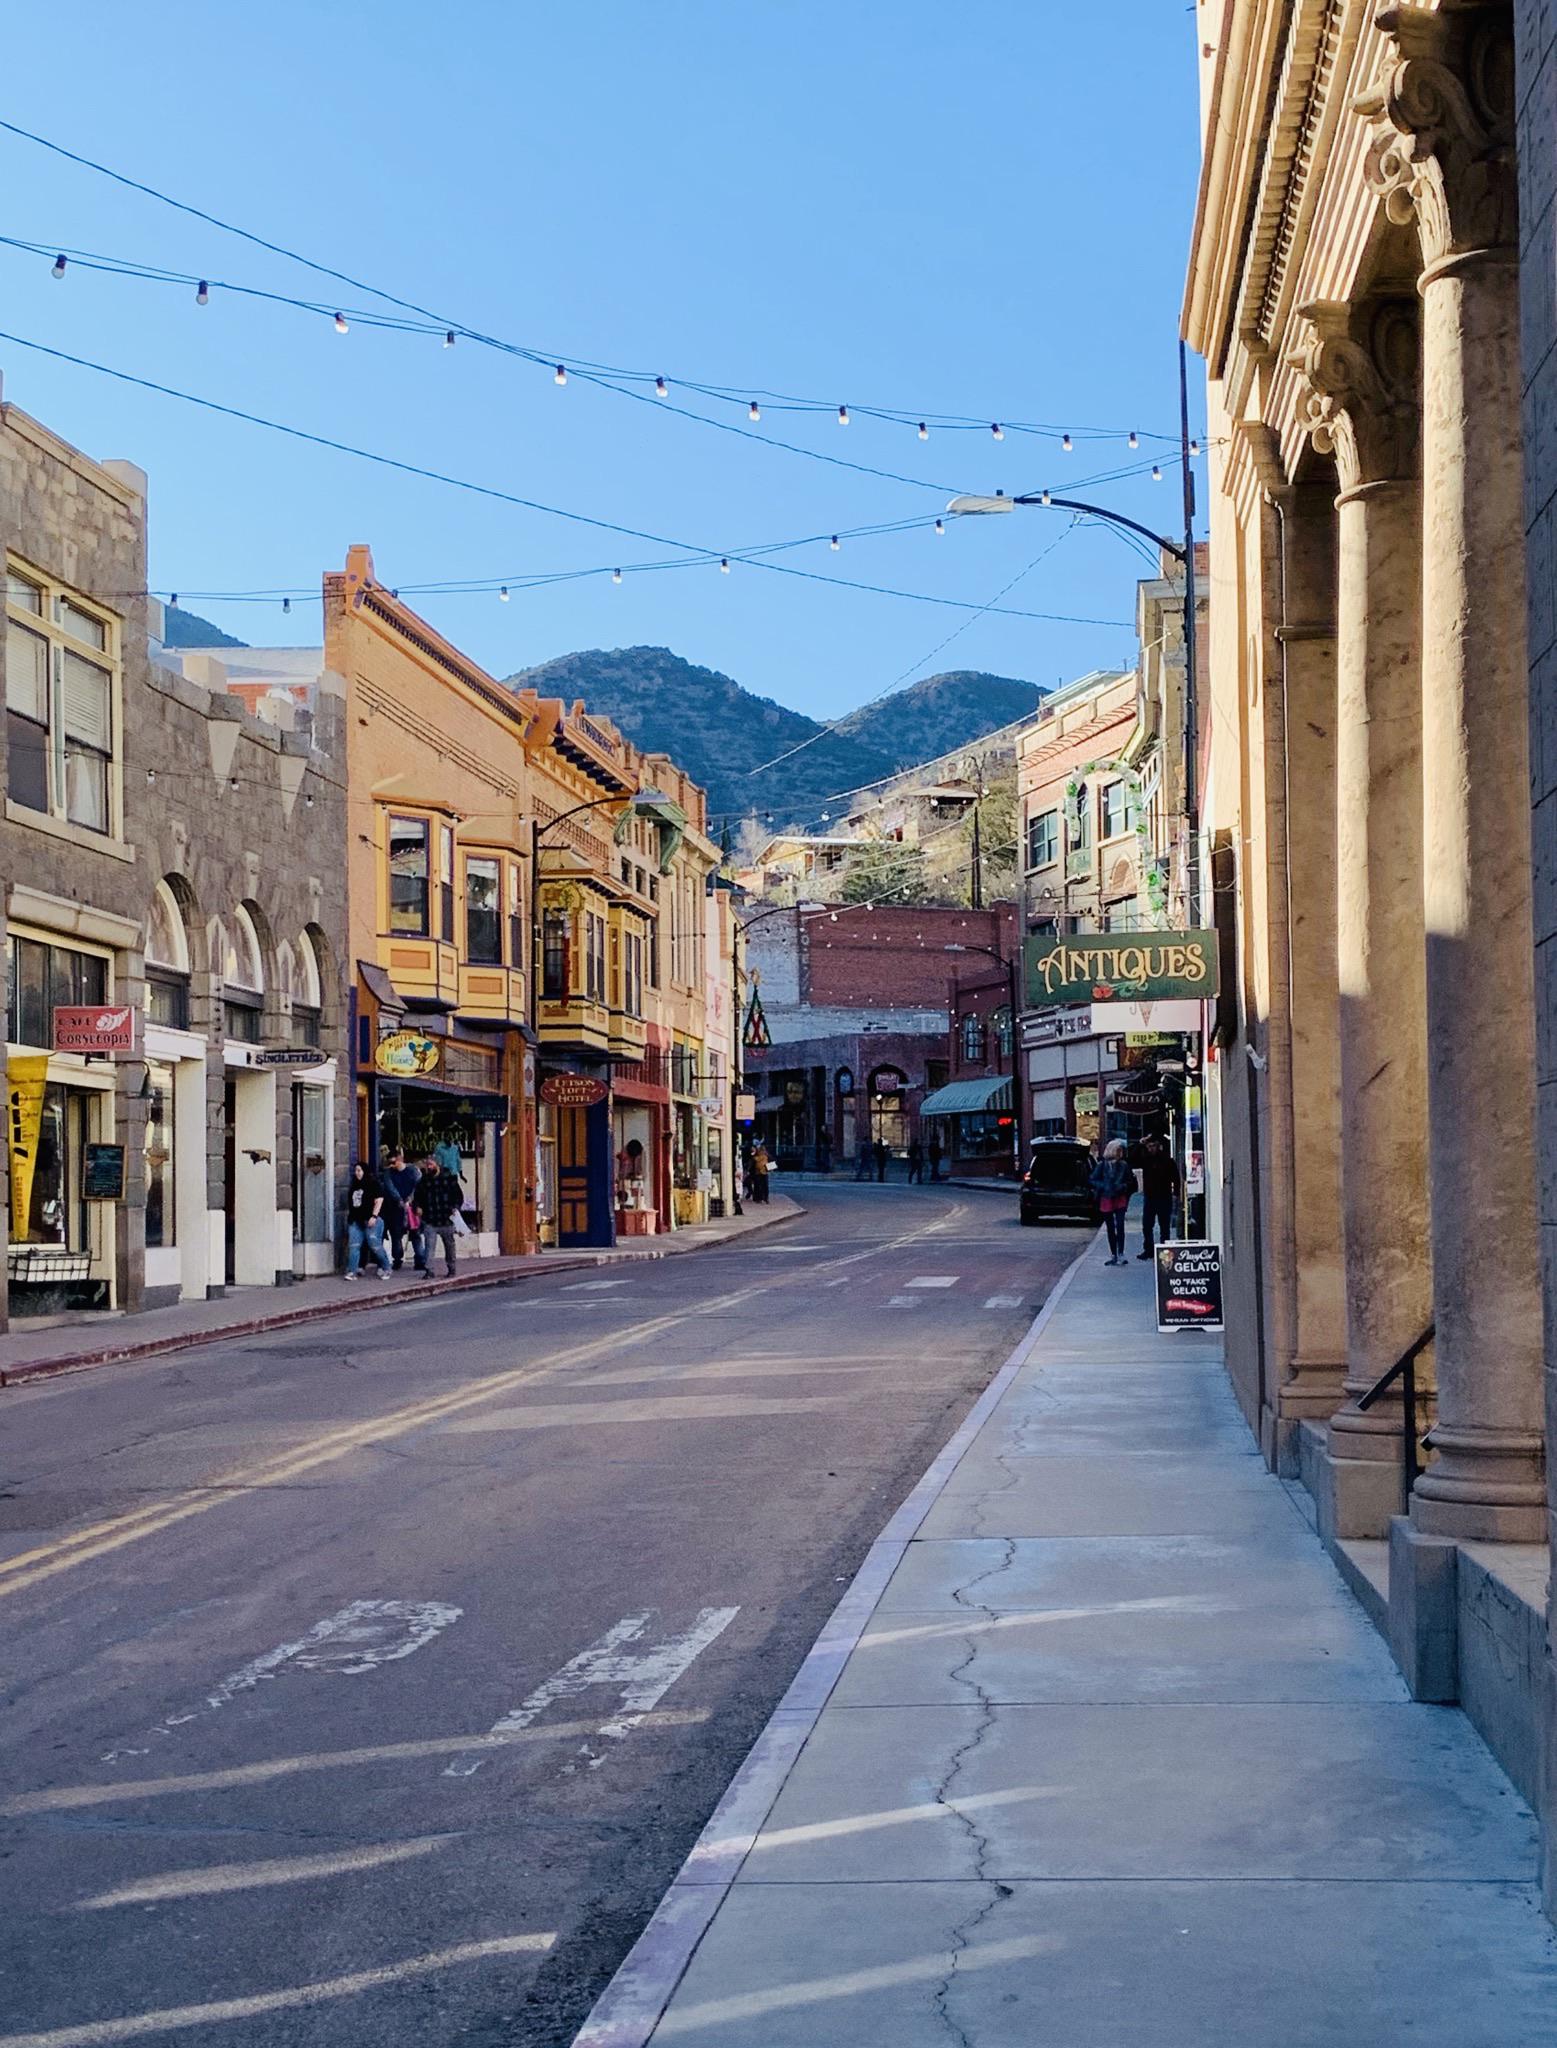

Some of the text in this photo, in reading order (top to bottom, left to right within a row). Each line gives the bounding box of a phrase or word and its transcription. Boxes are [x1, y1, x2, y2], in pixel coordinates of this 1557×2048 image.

[1037, 943, 1207, 994] ANTIQUES
[557, 1094, 592, 1104] HOTEL
[1174, 1261, 1220, 1273] GELATO
[1169, 1278, 1182, 1286] NO
[1172, 1286, 1208, 1295] GELATO
